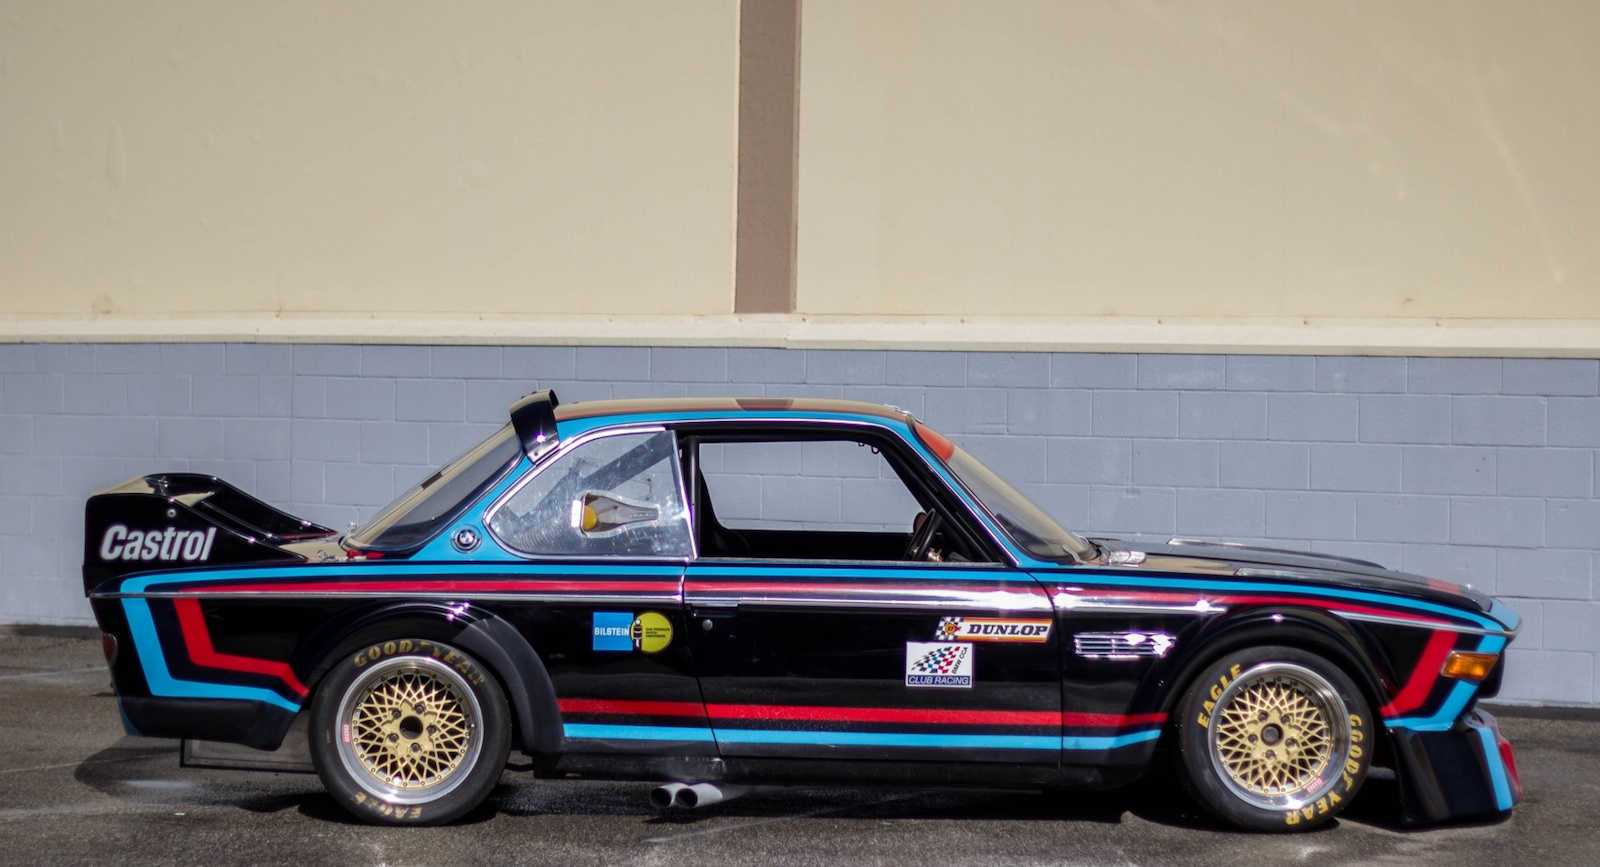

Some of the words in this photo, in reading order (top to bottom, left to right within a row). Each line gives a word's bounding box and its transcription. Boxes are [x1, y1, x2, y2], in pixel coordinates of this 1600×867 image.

[100, 524, 217, 561] Castrol
[594, 627, 630, 636] BILSTEIN
[967, 624, 1048, 636] DUNLOP
[908, 676, 934, 685] CLUB
[934, 676, 969, 685] RACING
[1197, 664, 1241, 728] EAGLE
